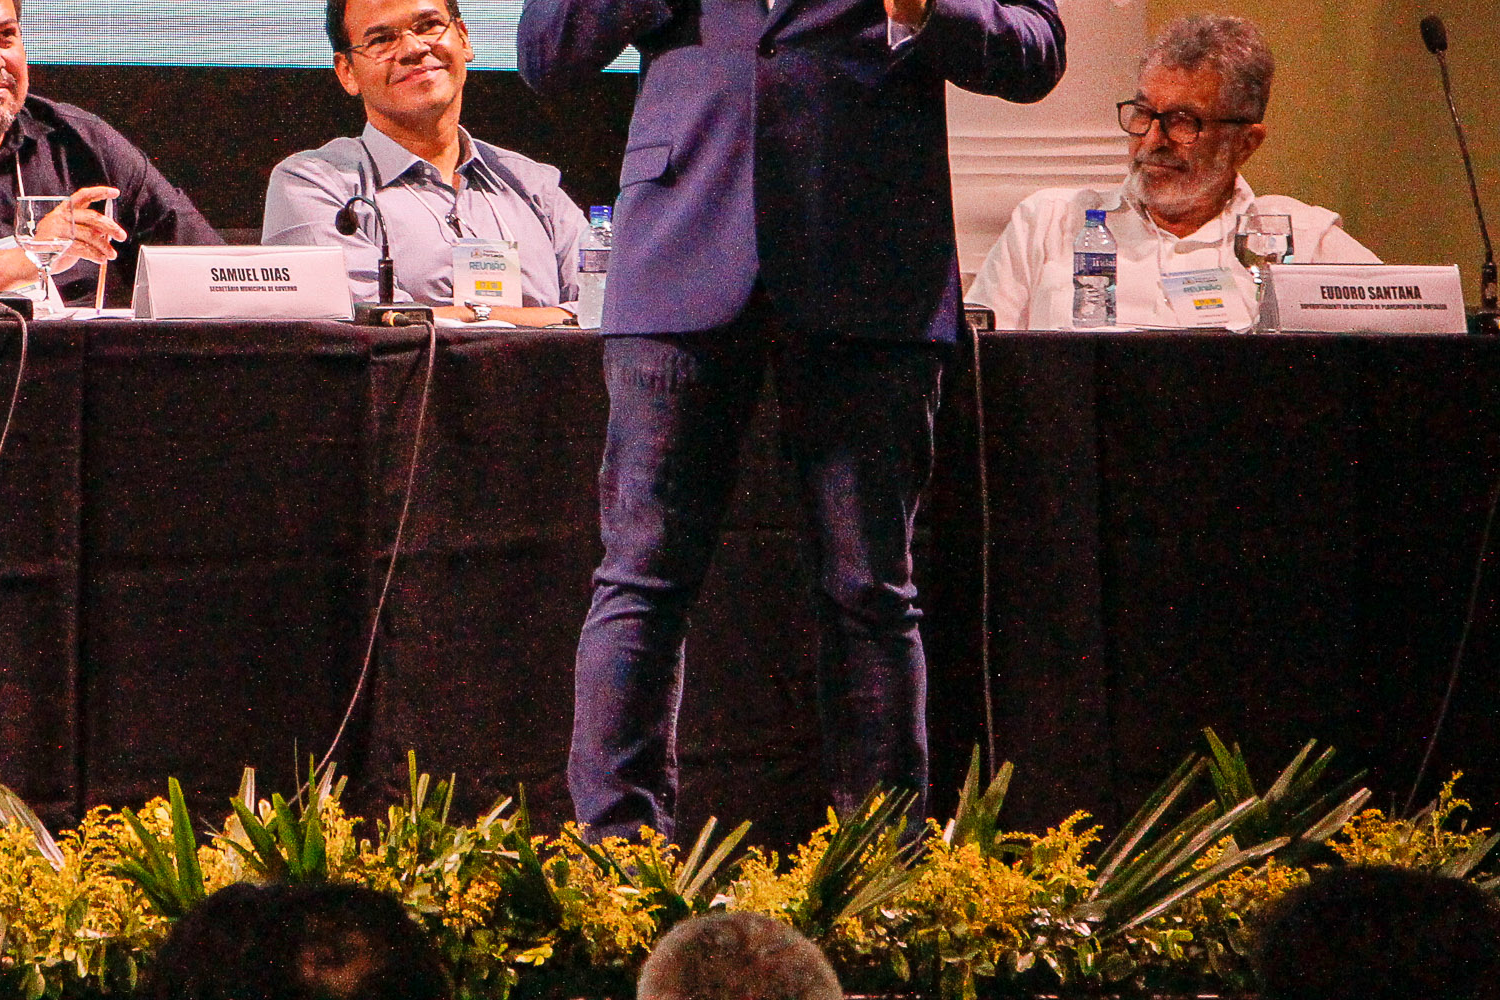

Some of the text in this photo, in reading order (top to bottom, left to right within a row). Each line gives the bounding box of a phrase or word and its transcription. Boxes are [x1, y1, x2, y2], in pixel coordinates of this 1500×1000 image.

[210, 267, 291, 282] SAMUEL DIAS
[1320, 285, 1422, 300] EUDORO SANTANA
